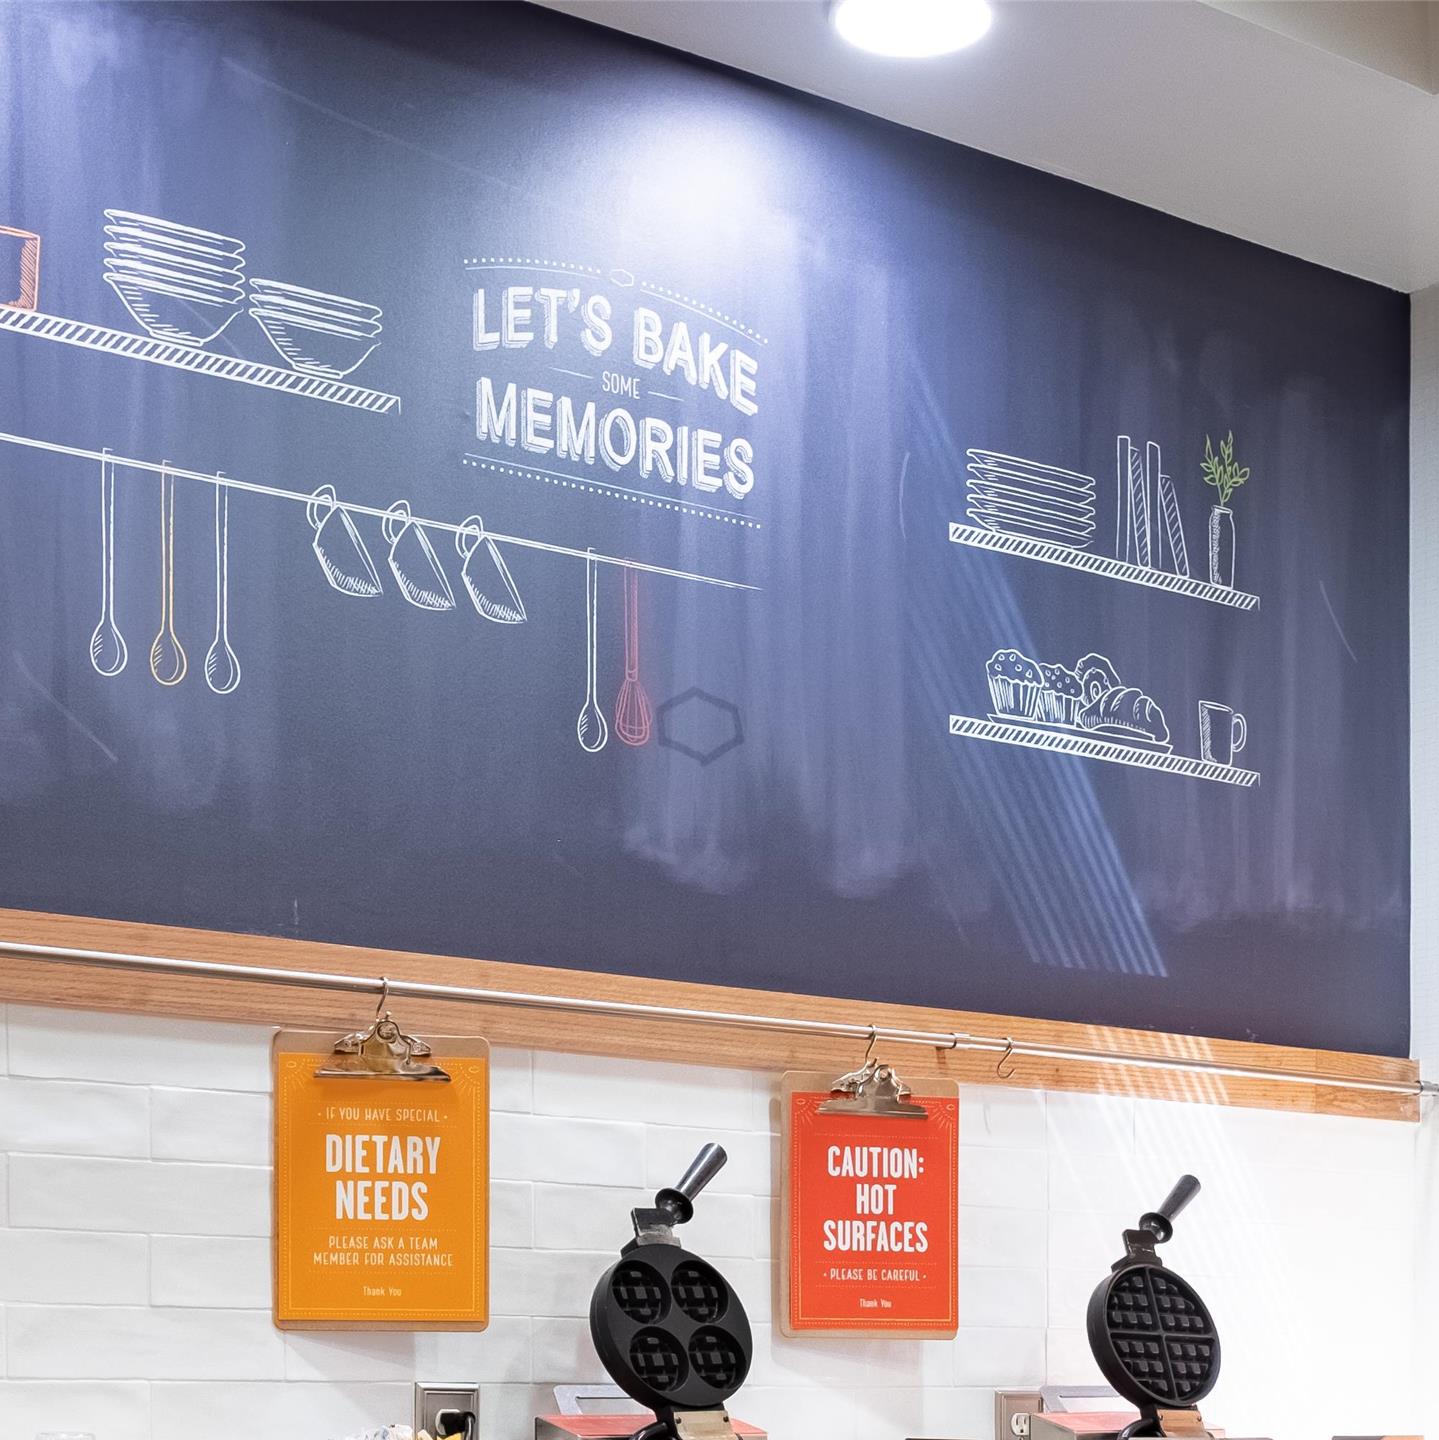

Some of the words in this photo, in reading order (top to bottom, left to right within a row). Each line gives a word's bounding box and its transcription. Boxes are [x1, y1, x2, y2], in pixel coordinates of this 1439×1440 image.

[472, 286, 612, 357] LET'S
[632, 306, 759, 416] BAKE
[601, 371, 641, 400] SOME
[476, 376, 755, 500] MEMORIES
[326, 1107, 336, 1119] IF
[339, 1107, 360, 1120] YOU
[364, 1108, 392, 1121] HAVE
[396, 1108, 440, 1123] SPECIAL
[325, 1134, 441, 1175] DIETARY
[827, 1145, 925, 1179] CAUTION:
[335, 1180, 429, 1222] NEEDS
[856, 1184, 897, 1215] HOT
[328, 1235, 369, 1249] PLEASE
[373, 1236, 394, 1249] ASK
[398, 1237, 405, 1249] A
[410, 1236, 438, 1250] TEAM
[823, 1219, 928, 1253] SURFACES
[313, 1252, 359, 1266] MEMBER
[364, 1252, 385, 1266] FOR
[389, 1253, 454, 1267] ASSISTANCE
[830, 1268, 863, 1281] PLEASE
[866, 1268, 878, 1281] BE
[881, 1269, 921, 1282] CAREFUL
[363, 1286, 385, 1297] Thank
[389, 1286, 402, 1297] You
[859, 1298, 878, 1308] Thank
[880, 1298, 892, 1309] You
